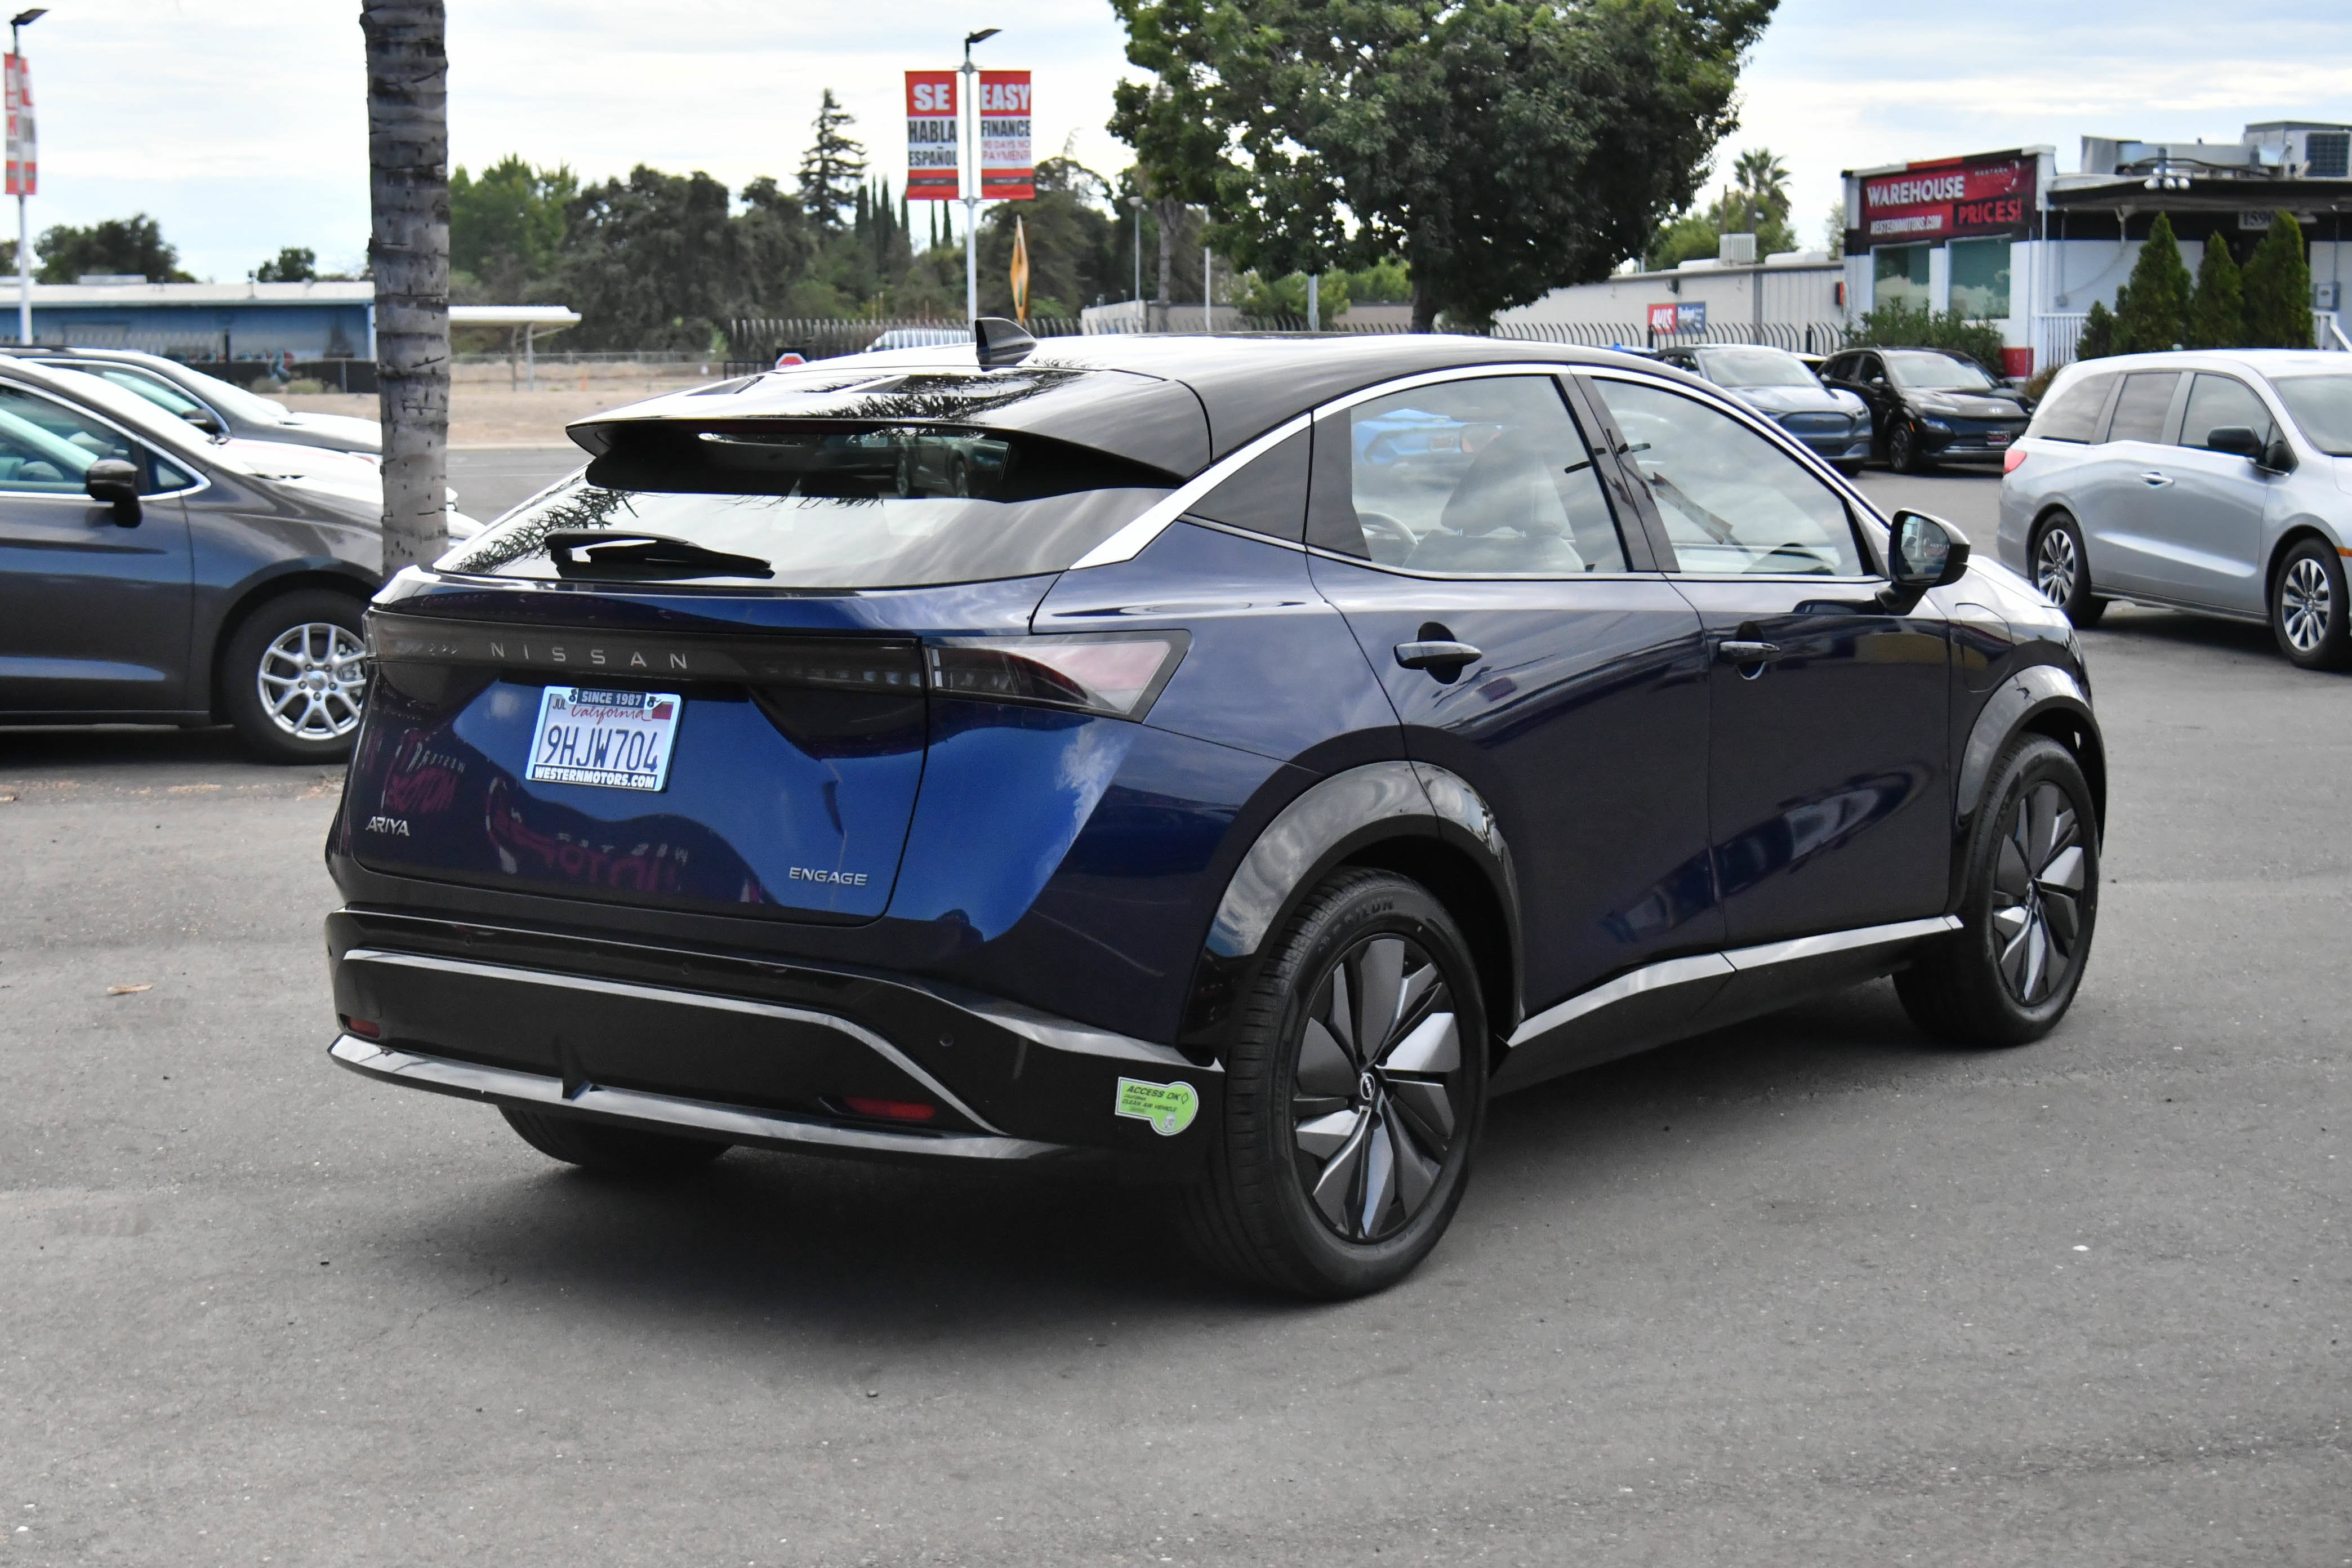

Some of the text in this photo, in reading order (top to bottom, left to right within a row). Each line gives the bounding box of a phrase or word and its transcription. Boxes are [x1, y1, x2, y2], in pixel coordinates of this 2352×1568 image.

[913, 83, 951, 110] SE
[981, 83, 1030, 110] EASY
[908, 119, 957, 142] HABLA
[981, 120, 1030, 136] FINANCE
[908, 146, 957, 166] ESPAÑOL
[1867, 175, 1965, 207] WAREHOUSE
[1958, 198, 2023, 224] PRICES!
[1869, 214, 1943, 235] WESTERNMOTORS.COM
[1651, 308, 1673, 329] AVIS
[491, 642, 688, 669] NISSAN
[553, 698, 566, 710] JUL
[581, 691, 642, 706] SINCE 1987
[571, 703, 652, 725] California
[543, 725, 658, 772] 9HJW704
[534, 766, 656, 789] WESTERNMOTORS.COM
[365, 816, 410, 837] ARIYA
[789, 866, 868, 886] ENGAGE
[1126, 1085, 1182, 1101] ACCESS OK
